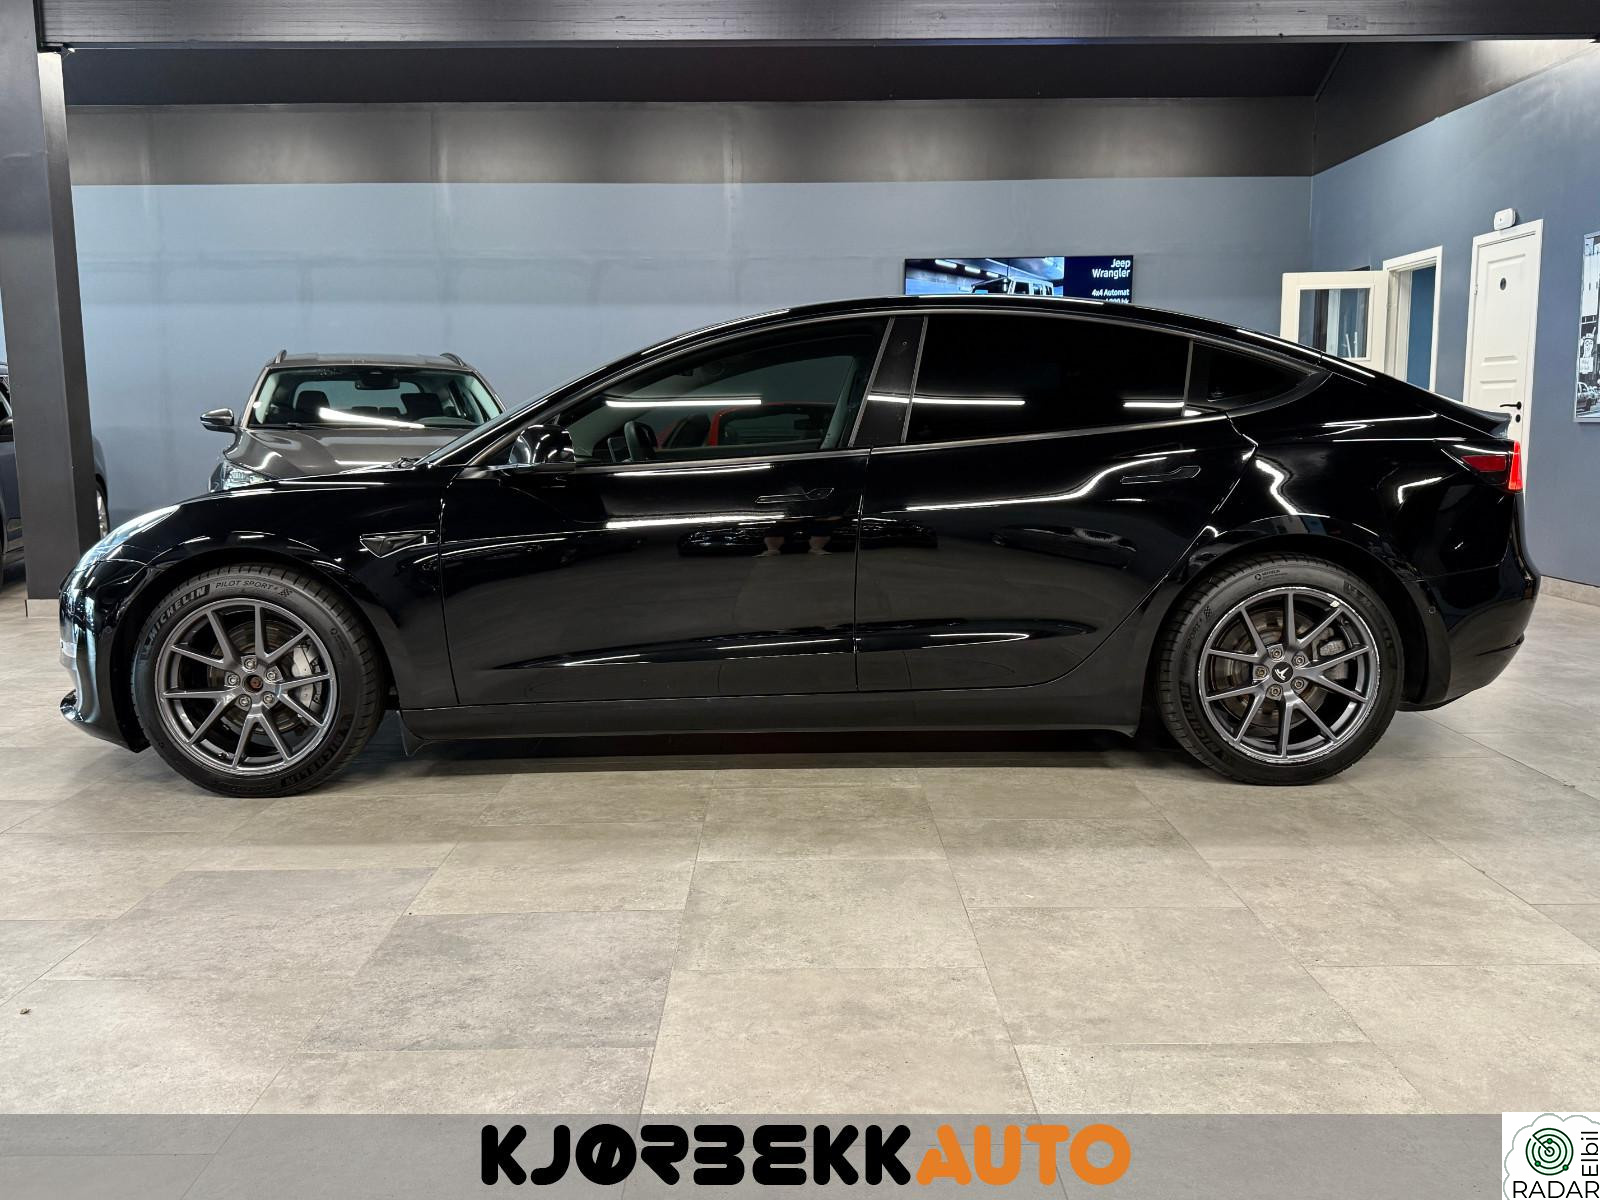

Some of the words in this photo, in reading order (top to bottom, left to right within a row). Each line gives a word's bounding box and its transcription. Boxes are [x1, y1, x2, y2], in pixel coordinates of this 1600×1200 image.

[1110, 258, 1131, 269] Jeep
[1092, 268, 1130, 279] Wrangler
[215, 580, 240, 589] PILOT
[243, 580, 274, 590] SPORT
[149, 585, 207, 642] MICHELIN
